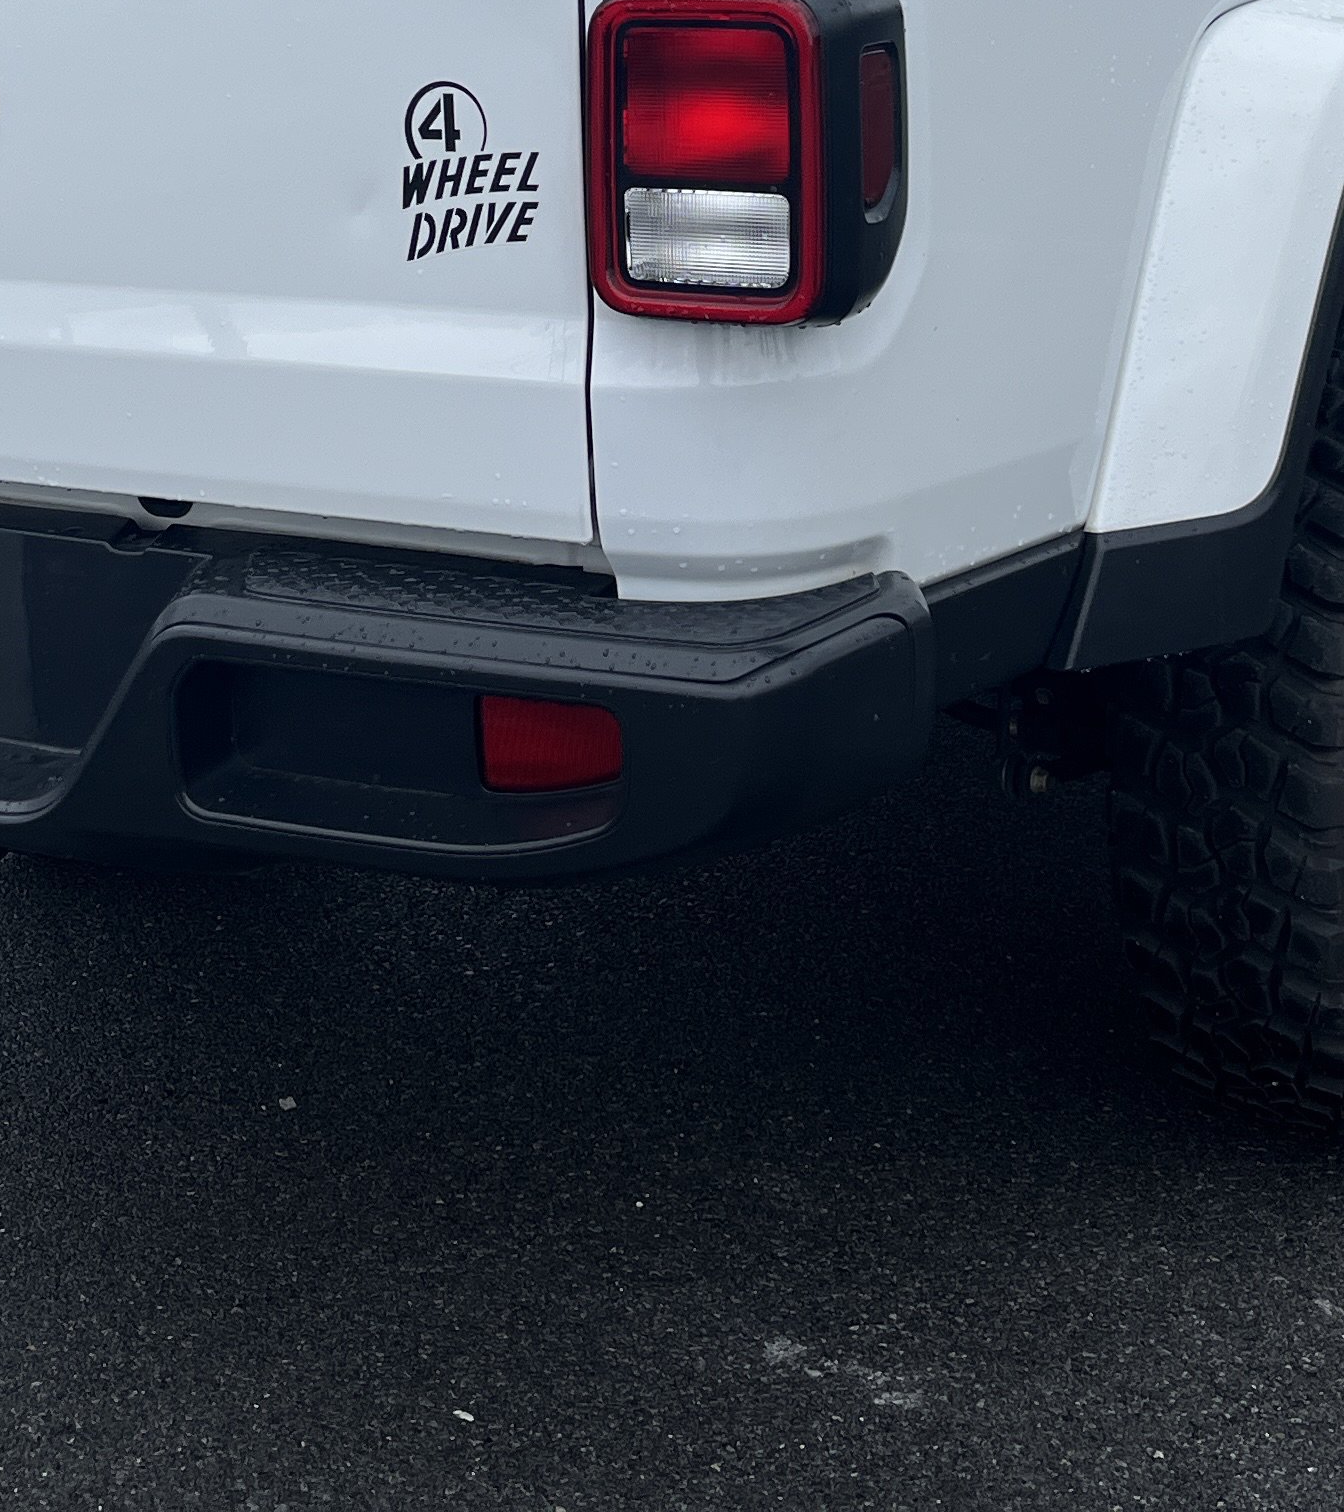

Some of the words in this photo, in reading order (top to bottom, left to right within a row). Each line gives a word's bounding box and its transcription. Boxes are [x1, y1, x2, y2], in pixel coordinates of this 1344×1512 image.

[417, 92, 461, 153] 4
[402, 151, 540, 210] WHEEL
[406, 201, 540, 262] DRIVE
